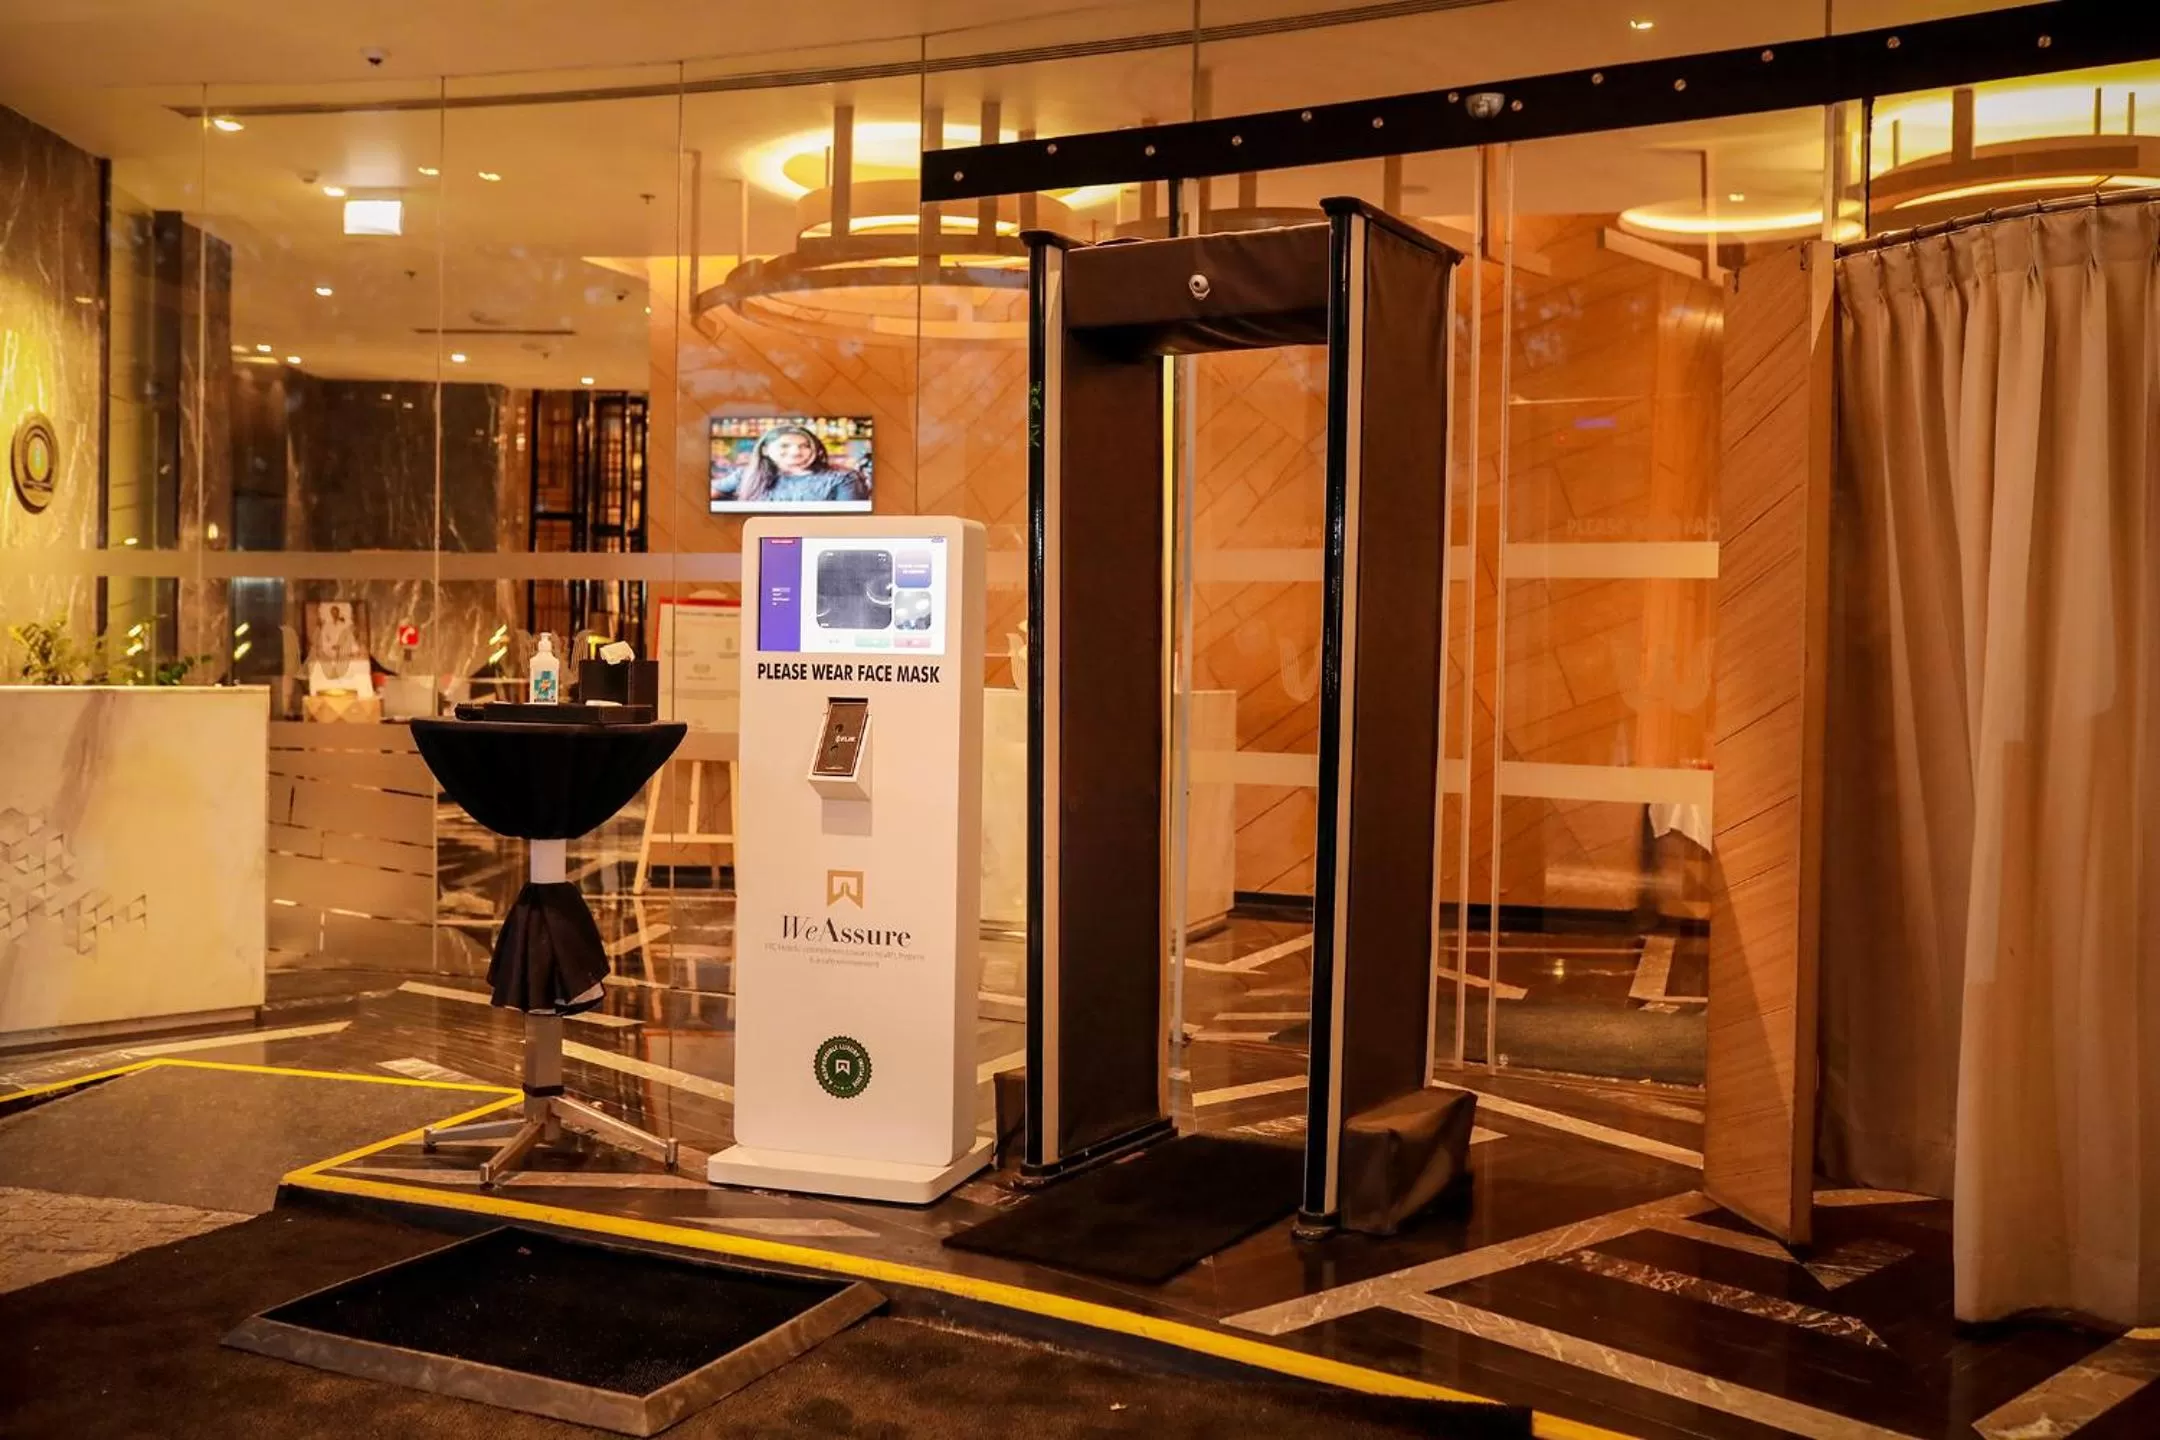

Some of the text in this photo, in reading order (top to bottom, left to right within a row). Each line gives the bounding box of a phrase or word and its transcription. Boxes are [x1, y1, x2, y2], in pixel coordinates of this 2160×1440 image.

[758, 663, 940, 683] PLEASE WEAR FACE MASK
